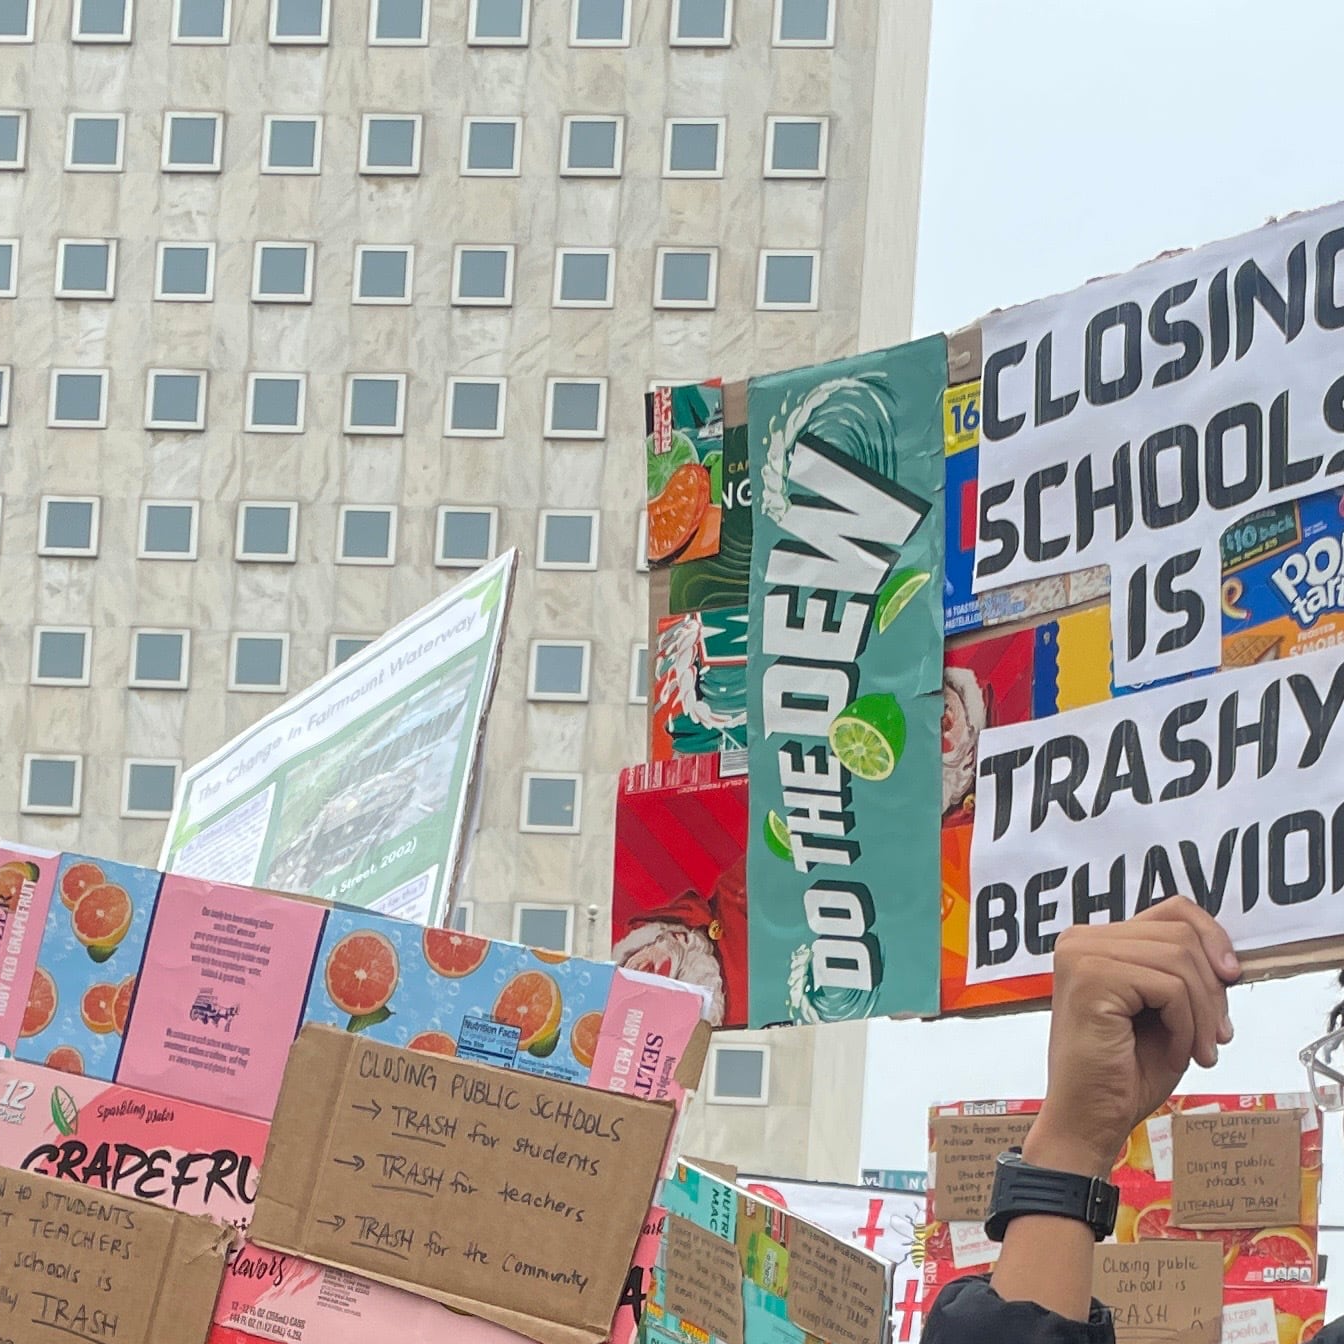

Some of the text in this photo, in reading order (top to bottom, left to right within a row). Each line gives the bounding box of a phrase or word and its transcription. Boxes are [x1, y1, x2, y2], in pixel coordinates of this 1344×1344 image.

[951, 401, 979, 434] 16
[1127, 550, 1204, 661] IS
[199, 776, 221, 802] The
[225, 735, 282, 786] Change
[307, 669, 385, 732] Fairmount
[389, 611, 477, 678] Waterway
[763, 432, 929, 993] DO THE DEW
[379, 836, 418, 870] 2002)
[8, 877, 39, 956] GRAPEFRUIT
[1, 954, 16, 983] RED
[633, 1031, 664, 1099] SELT
[359, 1049, 624, 1144] CLOSING PUBLIC SCHOOLS
[391, 1105, 600, 1177] TRASH for students
[1185, 1117, 1218, 1135] Keep
[20, 1140, 259, 1206] GRAPEFRU
[1234, 1154, 1275, 1170] public
[1253, 1175, 1265, 1186] is
[377, 1152, 586, 1223] TRASH for teachers
[1176, 1196, 1236, 1212] LITERALLY
[355, 1215, 415, 1251] TRASH
[424, 1230, 451, 1258] for
[463, 1241, 490, 1266] the
[95, 1269, 113, 1292] is
[1157, 1255, 1199, 1276] public
[1175, 1281, 1187, 1292] is
[32, 1291, 118, 1338] TRASH
